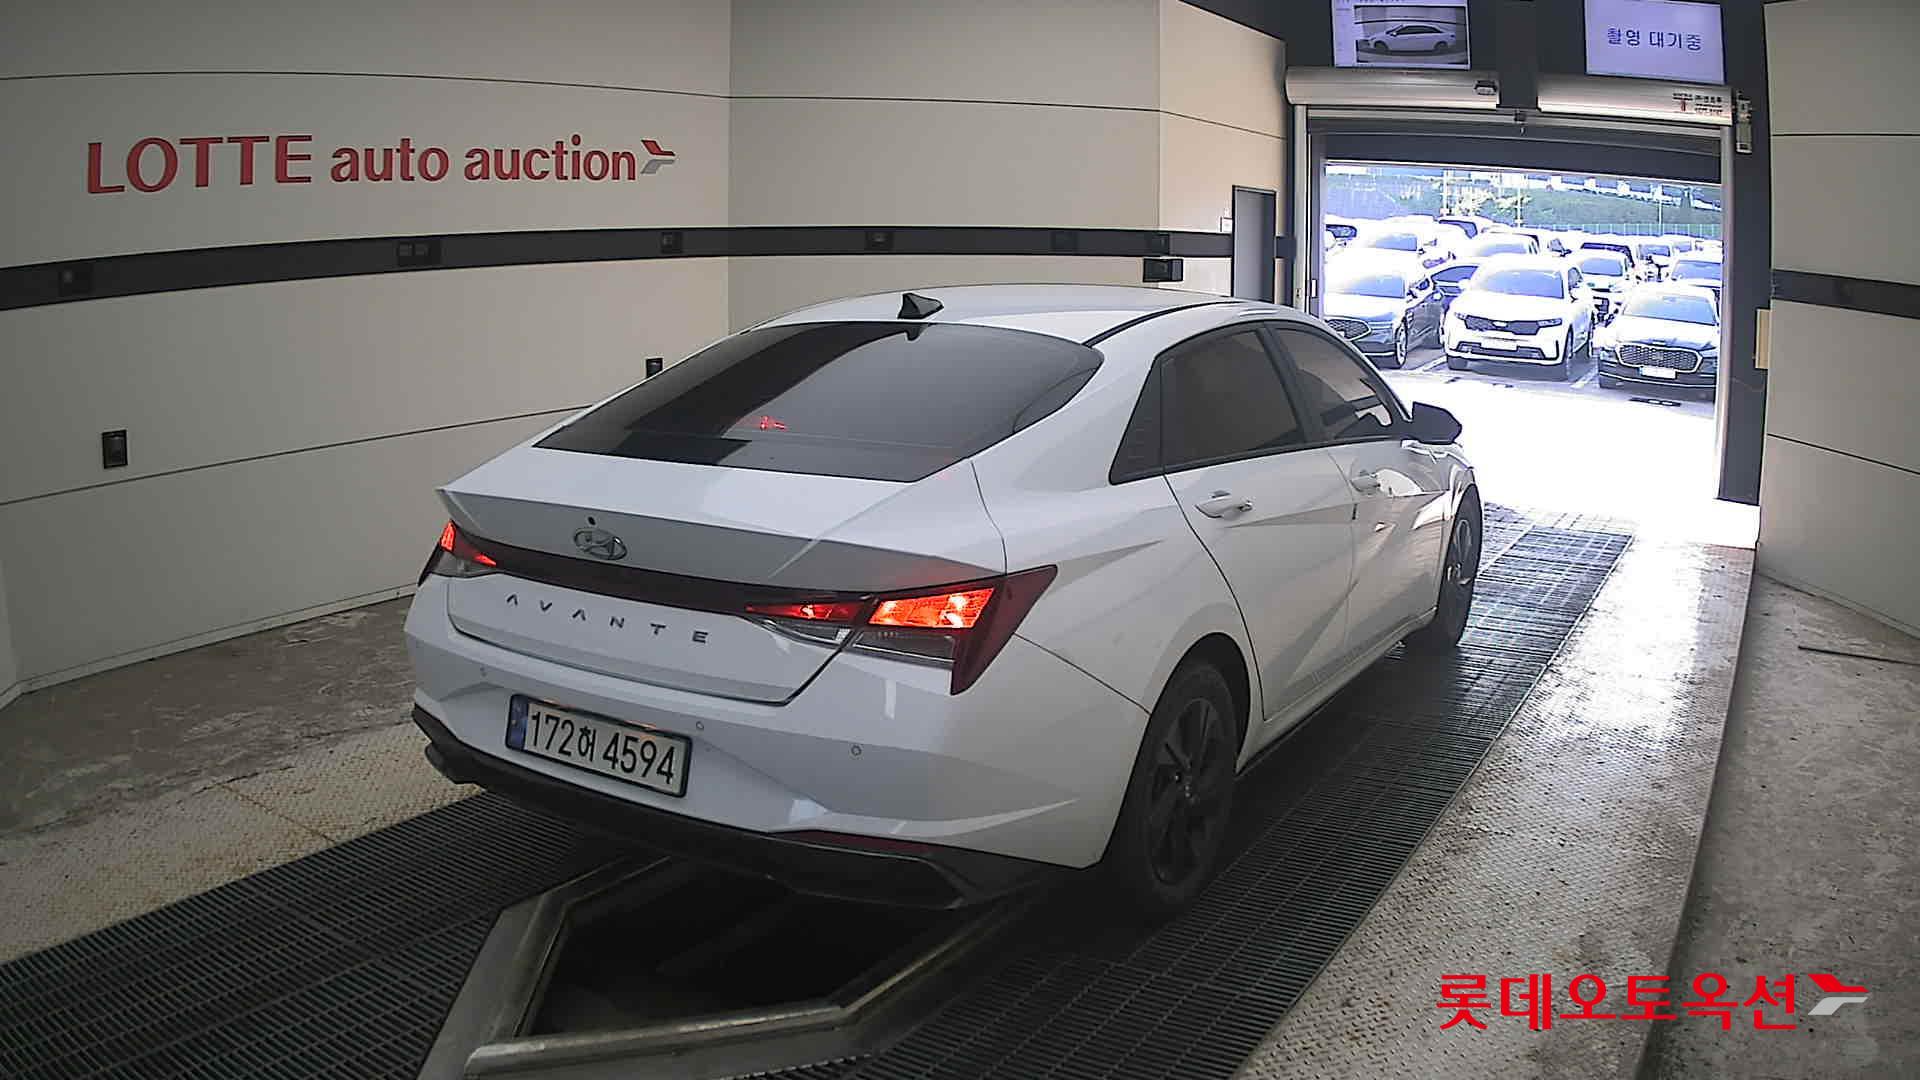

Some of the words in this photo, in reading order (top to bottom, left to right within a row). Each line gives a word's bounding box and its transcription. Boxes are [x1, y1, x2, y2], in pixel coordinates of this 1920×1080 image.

[1649, 31, 1702, 51] 대기중
[87, 135, 313, 194] LOTTE
[331, 138, 451, 183] auto
[464, 134, 637, 181] auction
[506, 594, 709, 644] AVANTE
